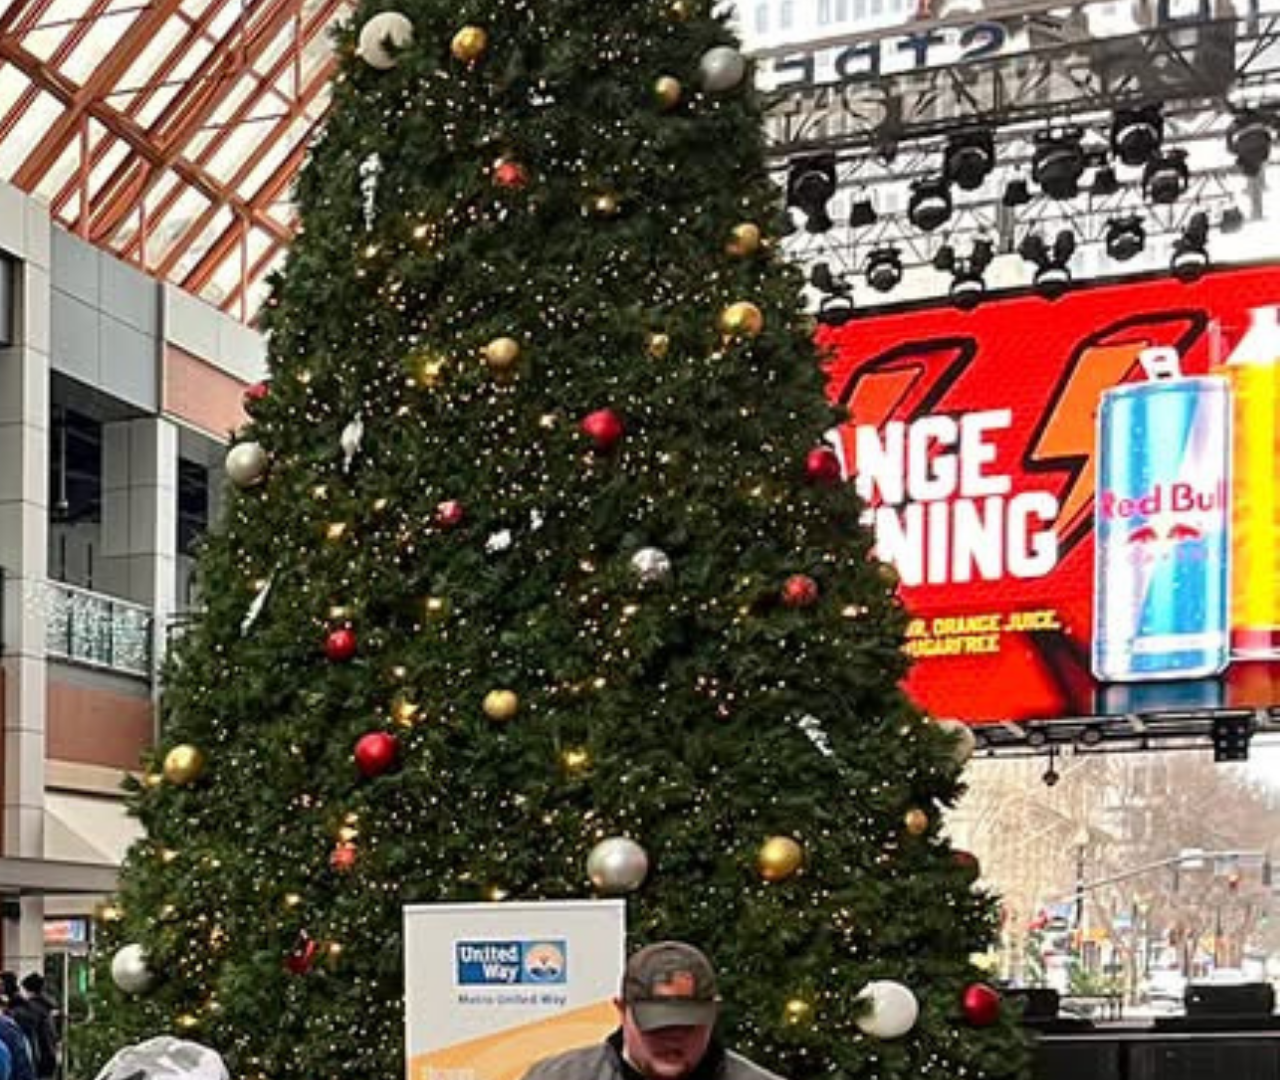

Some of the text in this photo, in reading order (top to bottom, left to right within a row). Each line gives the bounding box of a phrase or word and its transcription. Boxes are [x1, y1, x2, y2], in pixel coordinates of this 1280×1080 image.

[1101, 483, 1162, 519] Red
[859, 490, 1059, 588] NING
[461, 944, 519, 962] United
[482, 962, 519, 983] Way
